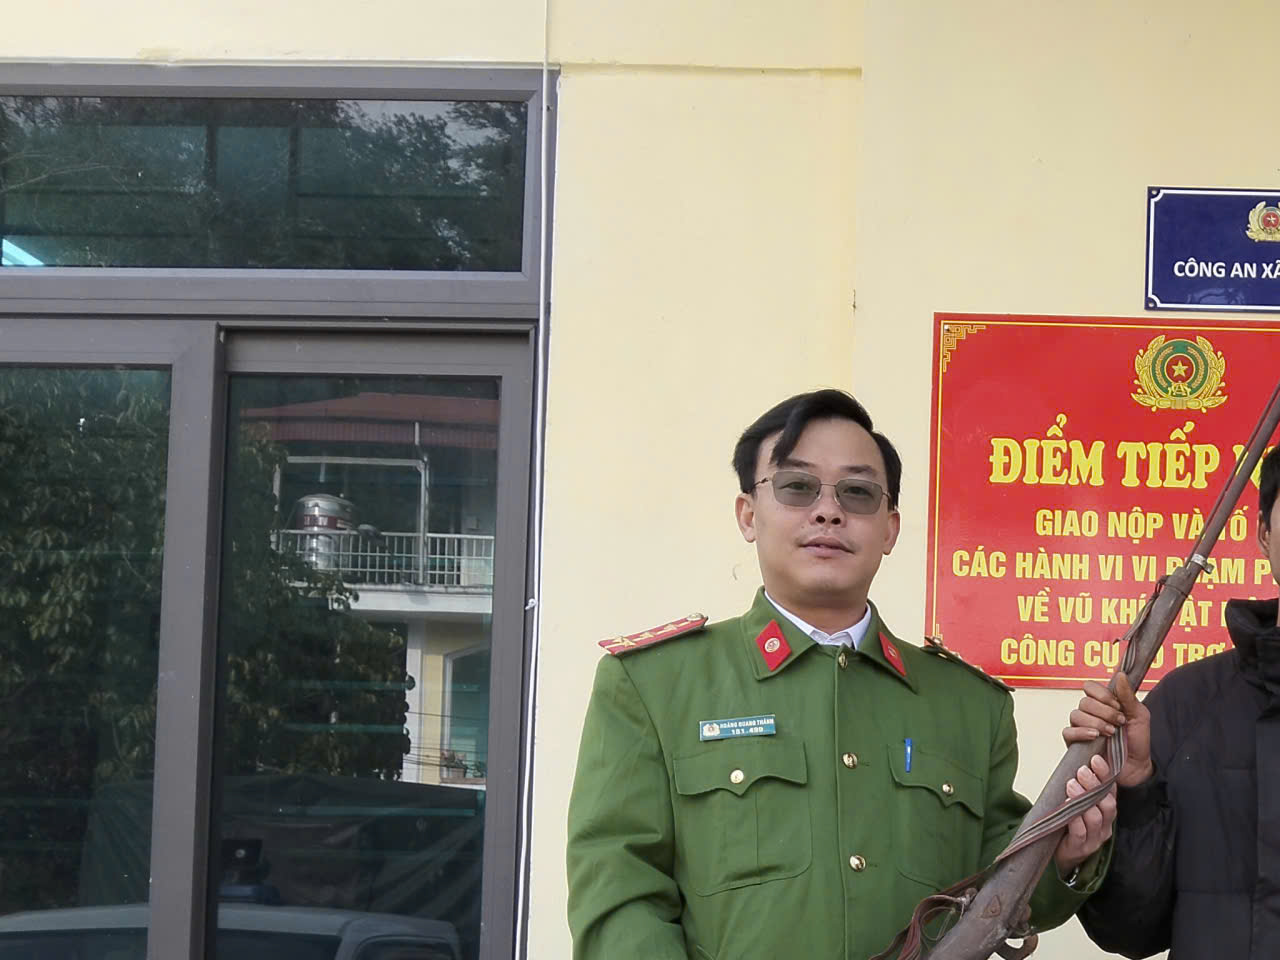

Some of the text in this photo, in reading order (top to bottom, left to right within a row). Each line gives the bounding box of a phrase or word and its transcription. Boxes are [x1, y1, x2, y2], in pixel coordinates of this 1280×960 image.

[1173, 257, 1226, 278] CÔNG
[1230, 262, 1257, 279] AN
[989, 413, 1105, 487] ĐIỂM
[1117, 421, 1219, 489] TIẾP
[1035, 505, 1248, 544] GIAO NỘP VÀ Ố
[952, 546, 1007, 578] CÁC
[1015, 547, 1090, 581] HÀNH
[1098, 554, 1123, 581] VI
[1132, 555, 1157, 582] VI
[1165, 556, 1245, 590] PẠM
[1017, 587, 1051, 623] VỀ
[1058, 592, 1093, 623] VŨ
[1172, 595, 1212, 632] ẬT
[1001, 634, 1075, 666] CÔNG
[1084, 641, 1120, 673] CỤ
